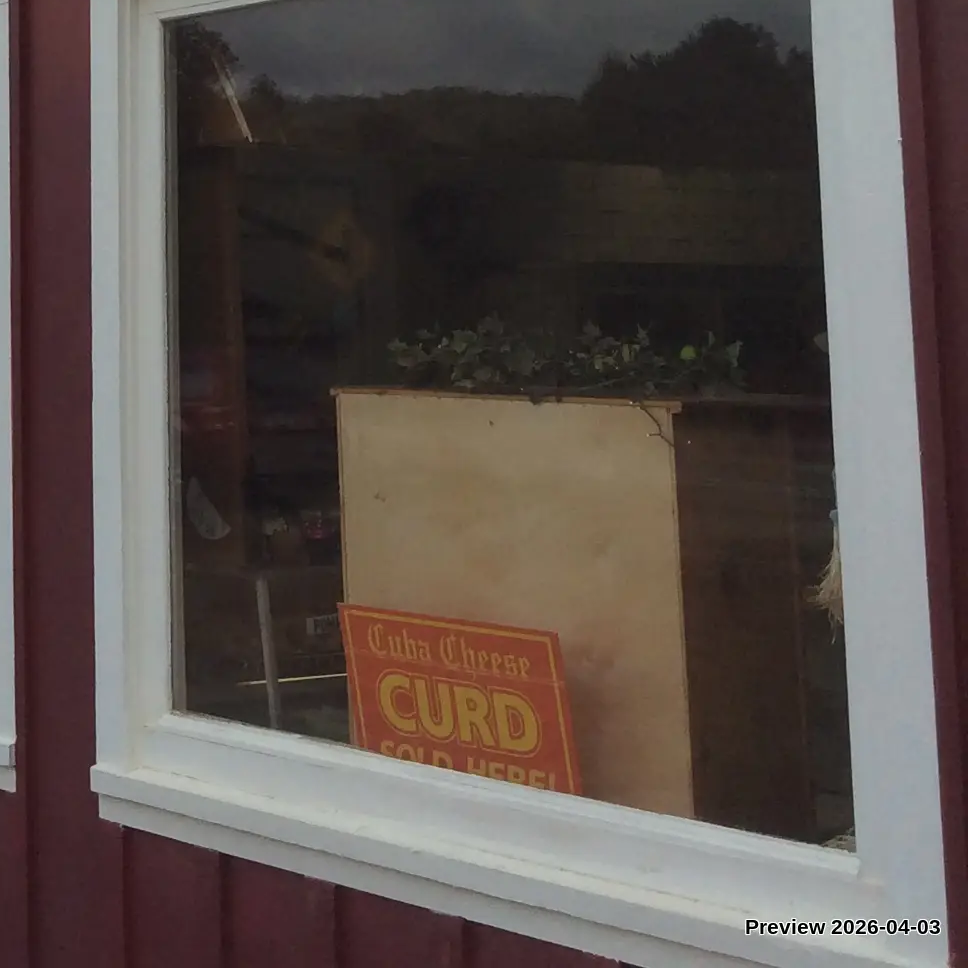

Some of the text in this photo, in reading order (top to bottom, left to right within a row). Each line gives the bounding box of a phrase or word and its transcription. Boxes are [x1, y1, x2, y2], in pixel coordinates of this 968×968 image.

[367, 623, 431, 661] Cuba
[439, 633, 531, 680] Cheese
[378, 670, 540, 757] CURD
